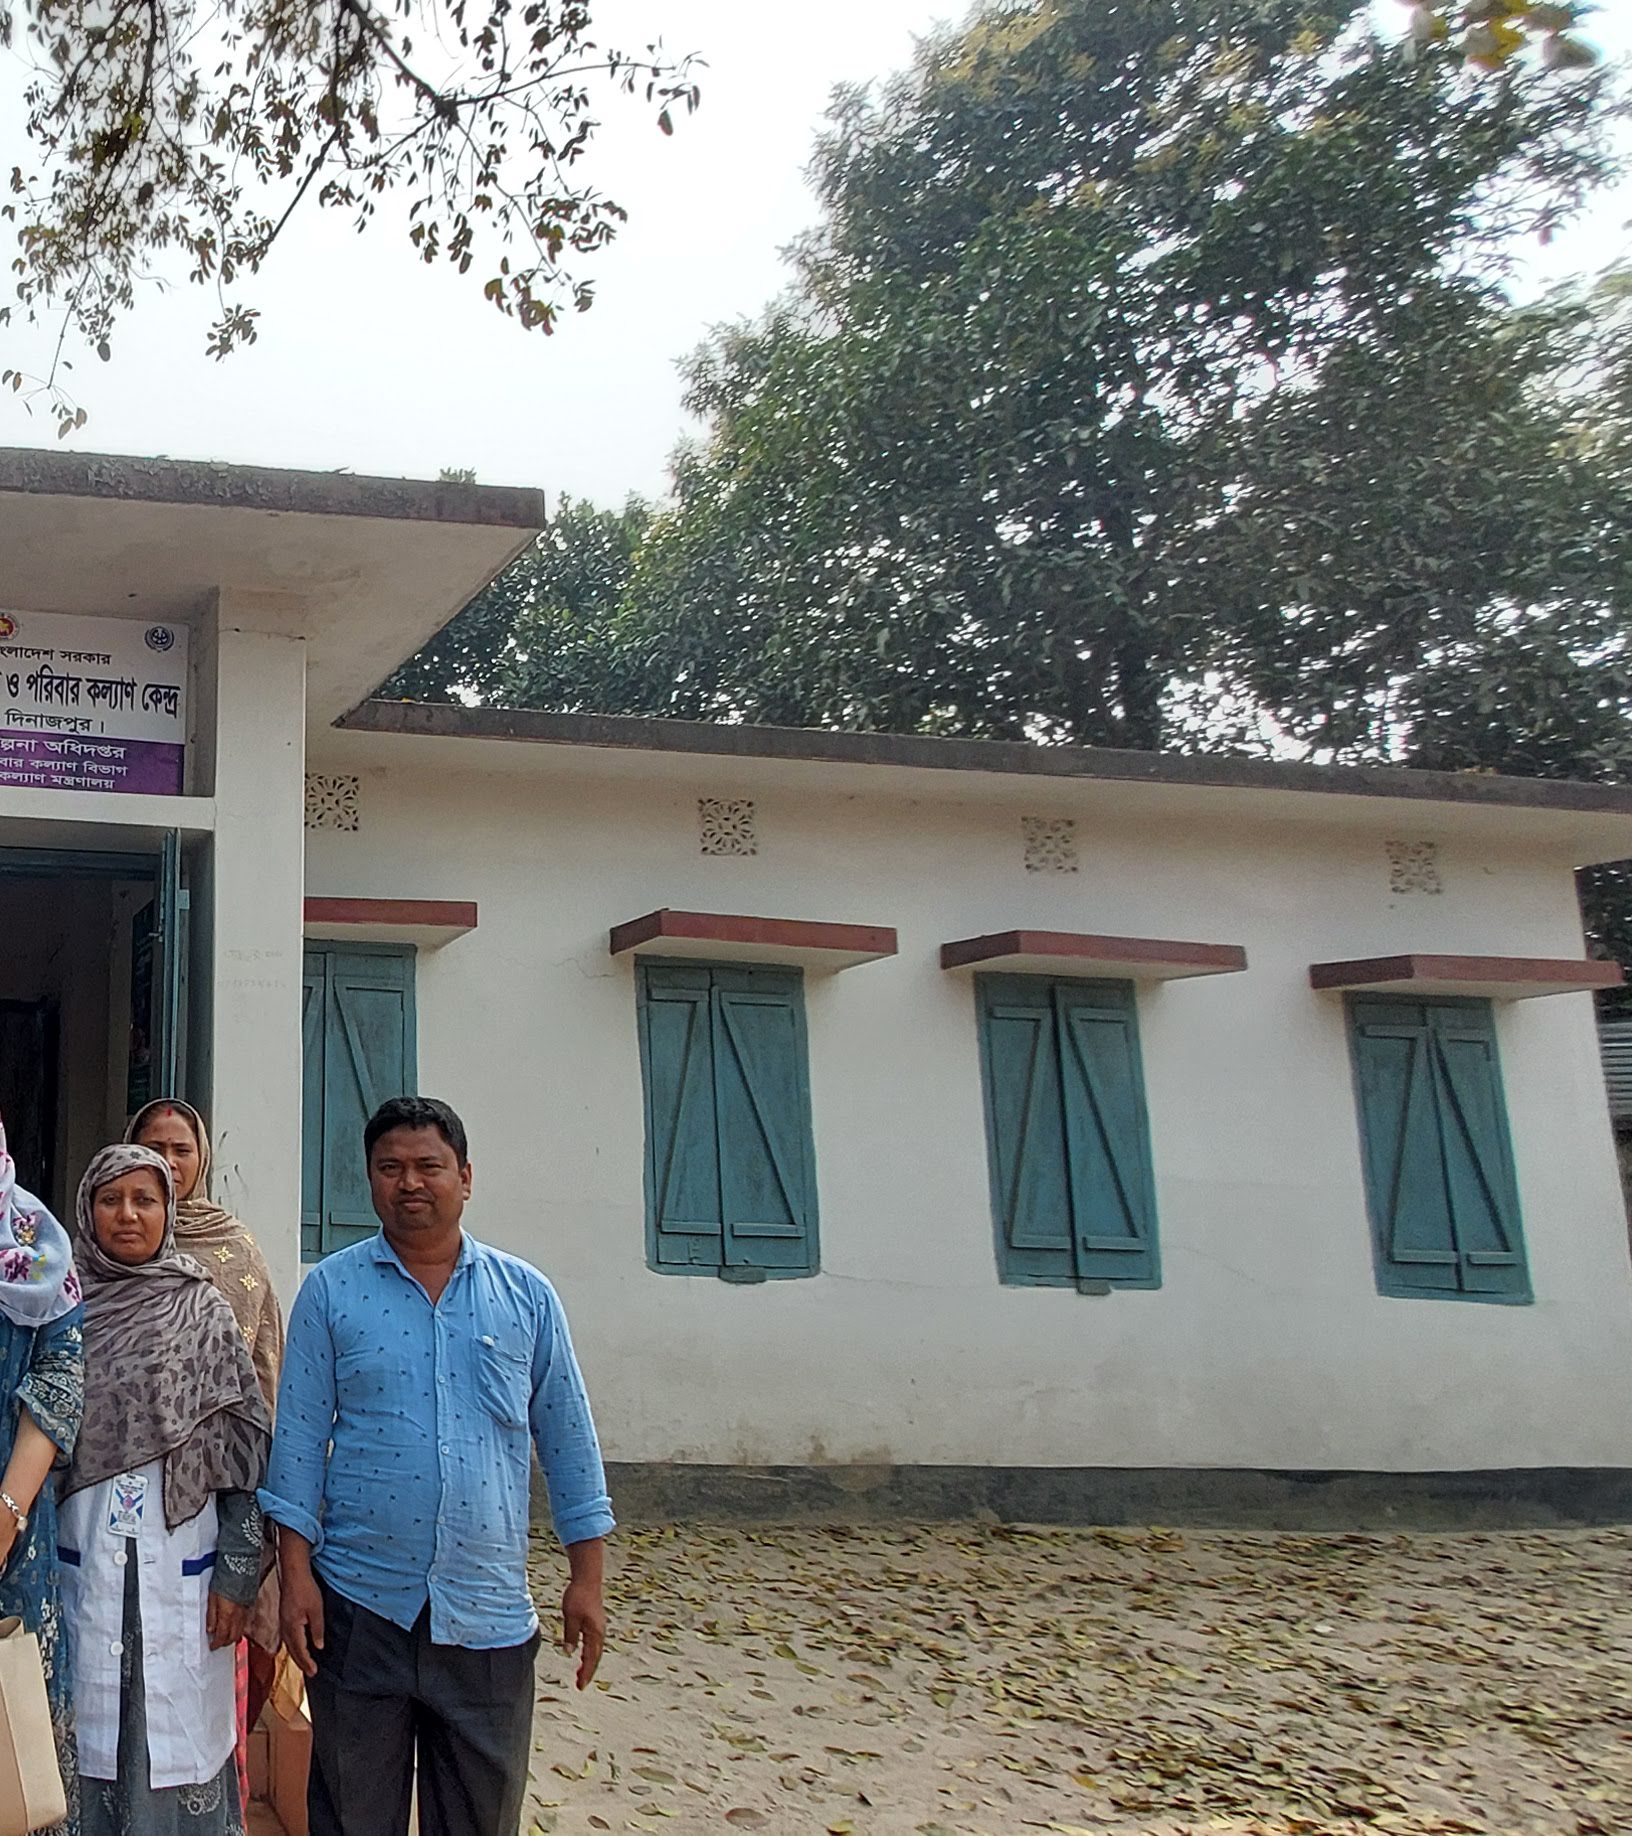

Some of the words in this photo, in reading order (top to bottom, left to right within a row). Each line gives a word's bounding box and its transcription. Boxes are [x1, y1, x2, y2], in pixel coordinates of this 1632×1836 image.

[60, 651, 112, 665] সরকার
[6, 672, 20, 698] ও
[26, 664, 83, 706] পরিবার
[86, 676, 138, 711] কল্যাণ
[142, 683, 181, 719] কেন্দ্র
[42, 738, 127, 759] অধিদপ্তর
[29, 760, 79, 772] কল্যাণ
[83, 760, 128, 777] বিভাগ
